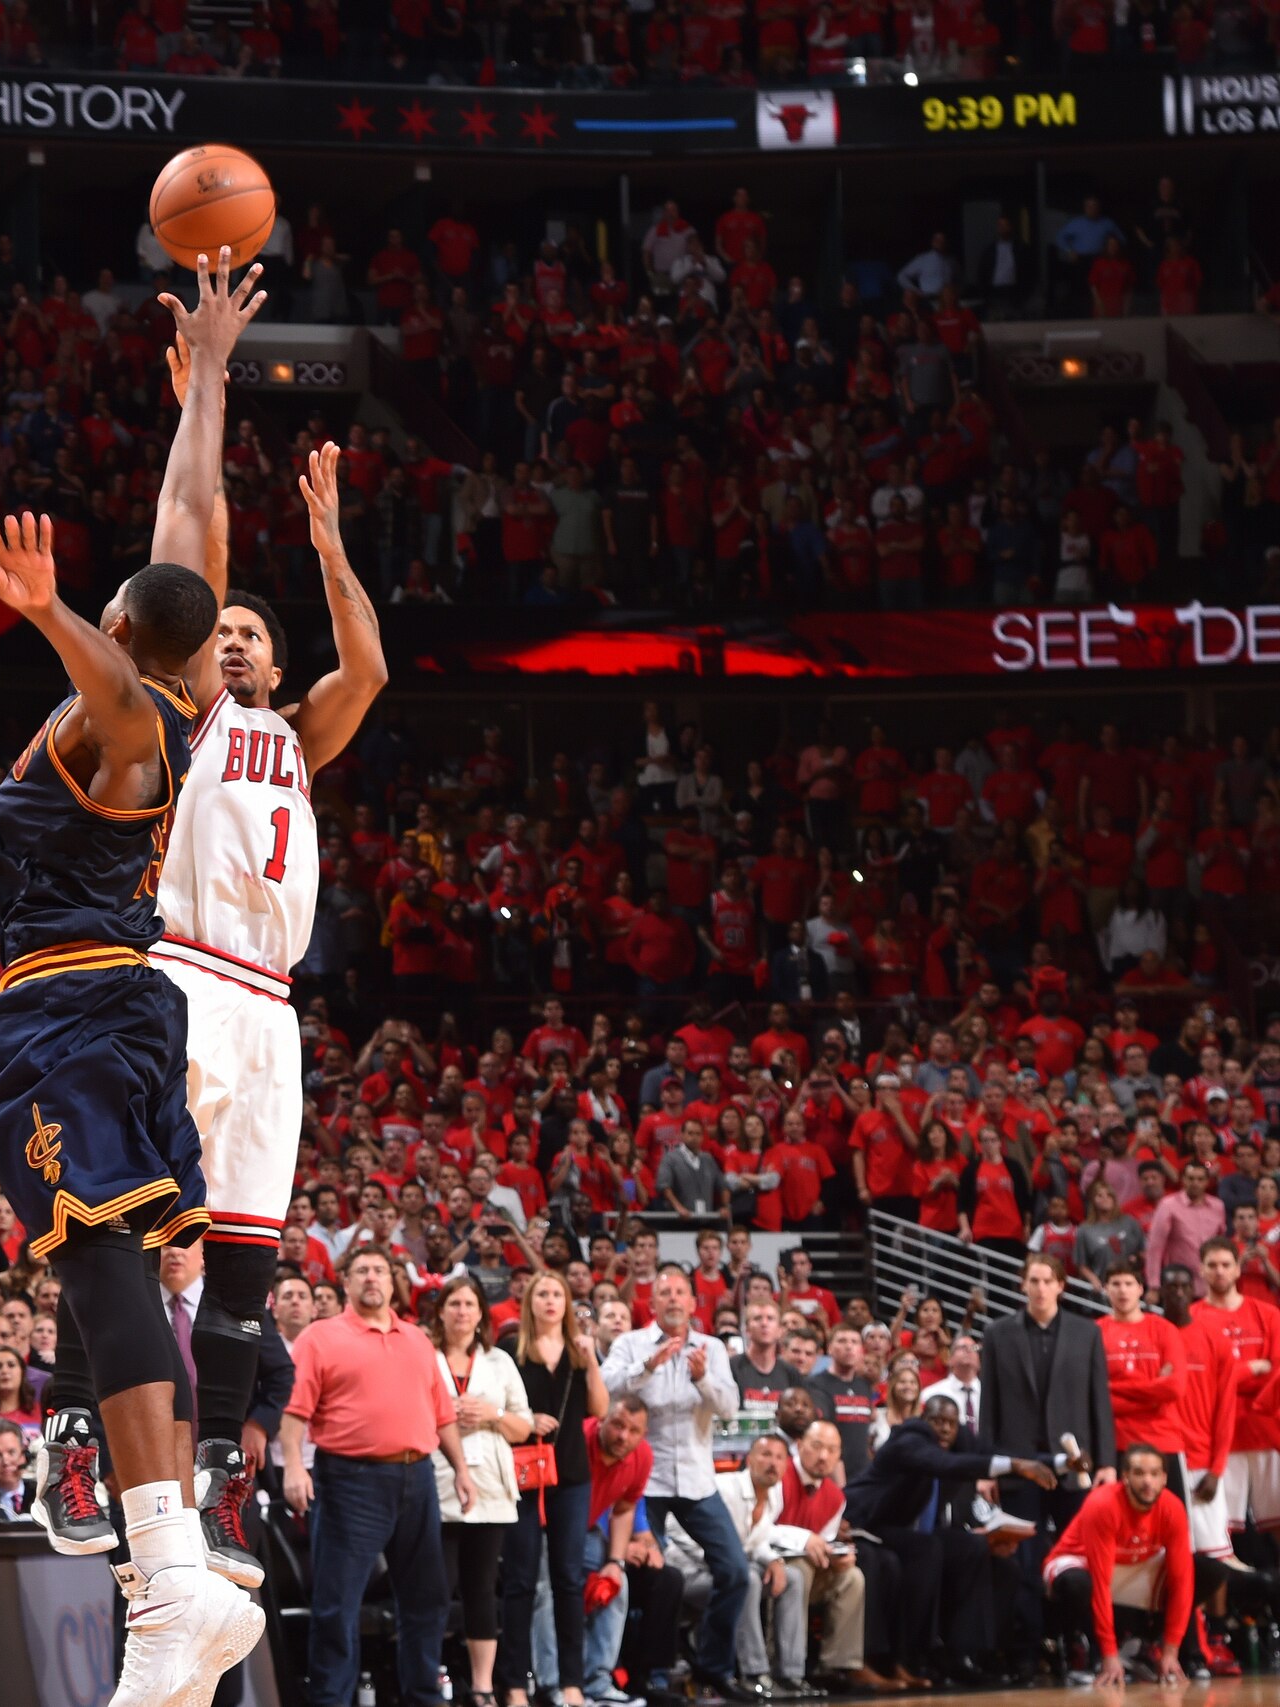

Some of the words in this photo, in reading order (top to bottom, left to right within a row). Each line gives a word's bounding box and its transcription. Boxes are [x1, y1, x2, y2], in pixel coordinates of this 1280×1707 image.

[922, 95, 1004, 131] 9:39
[1013, 91, 1077, 127] PM
[1202, 107, 1255, 133] LOS
[1259, 106, 1280, 130] A
[296, 362, 345, 384] 206
[991, 611, 1120, 671] SEE
[1193, 605, 1280, 664] DE
[263, 806, 290, 884] 1
